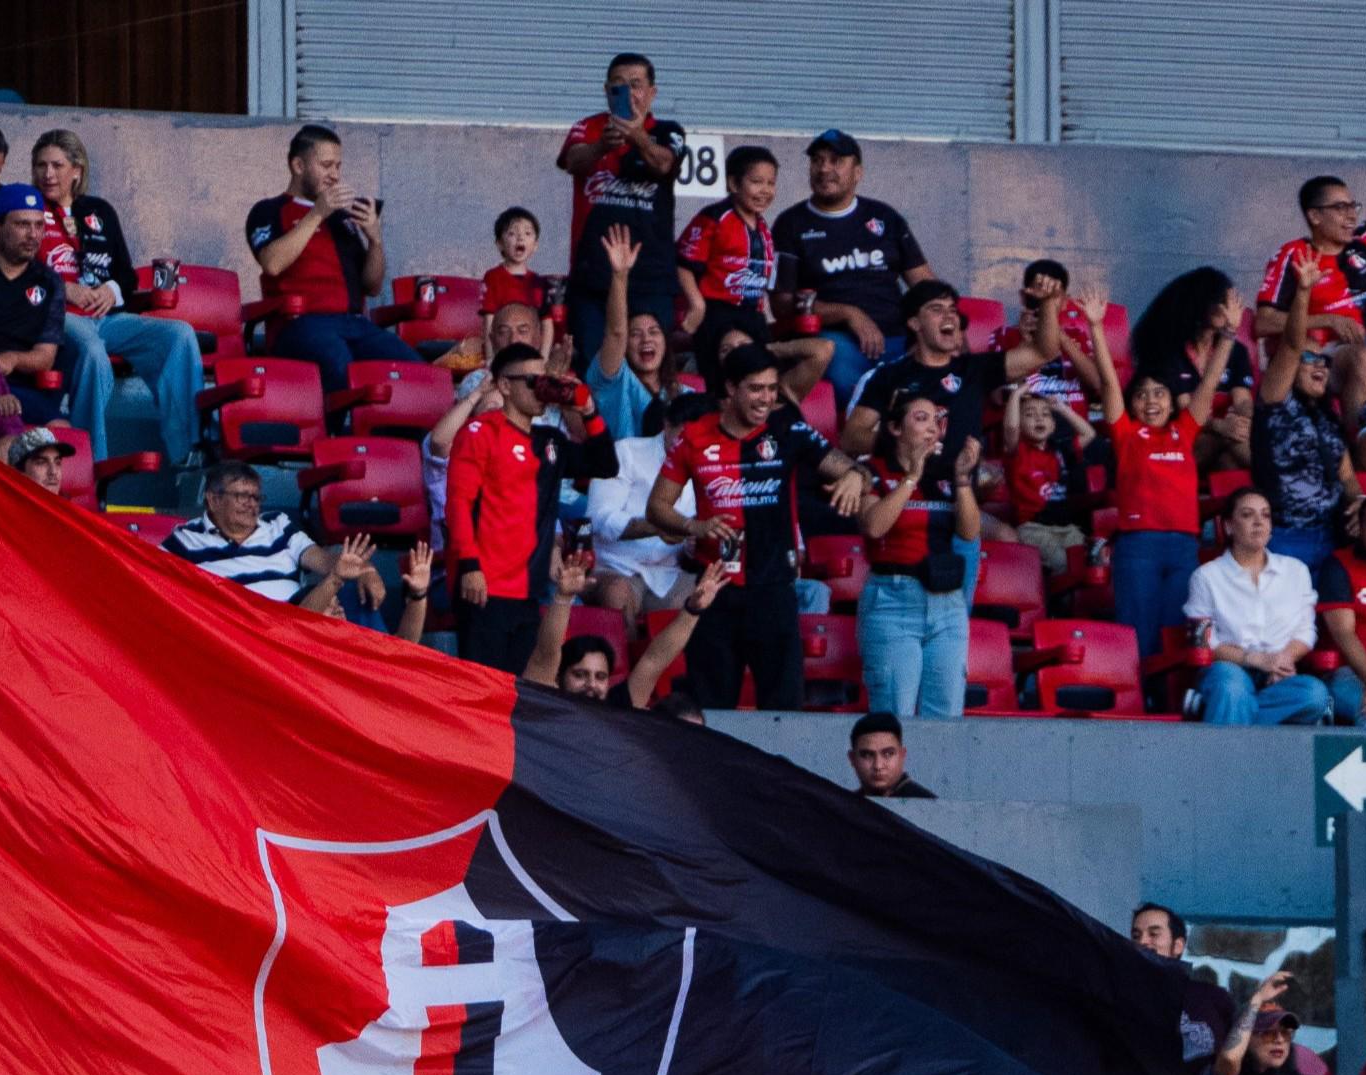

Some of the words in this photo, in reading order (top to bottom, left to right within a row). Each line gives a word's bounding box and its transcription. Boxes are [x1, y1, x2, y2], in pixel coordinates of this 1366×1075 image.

[676, 145, 718, 186] 08
[822, 248, 885, 274] wibe
[706, 475, 784, 499] Caliente
